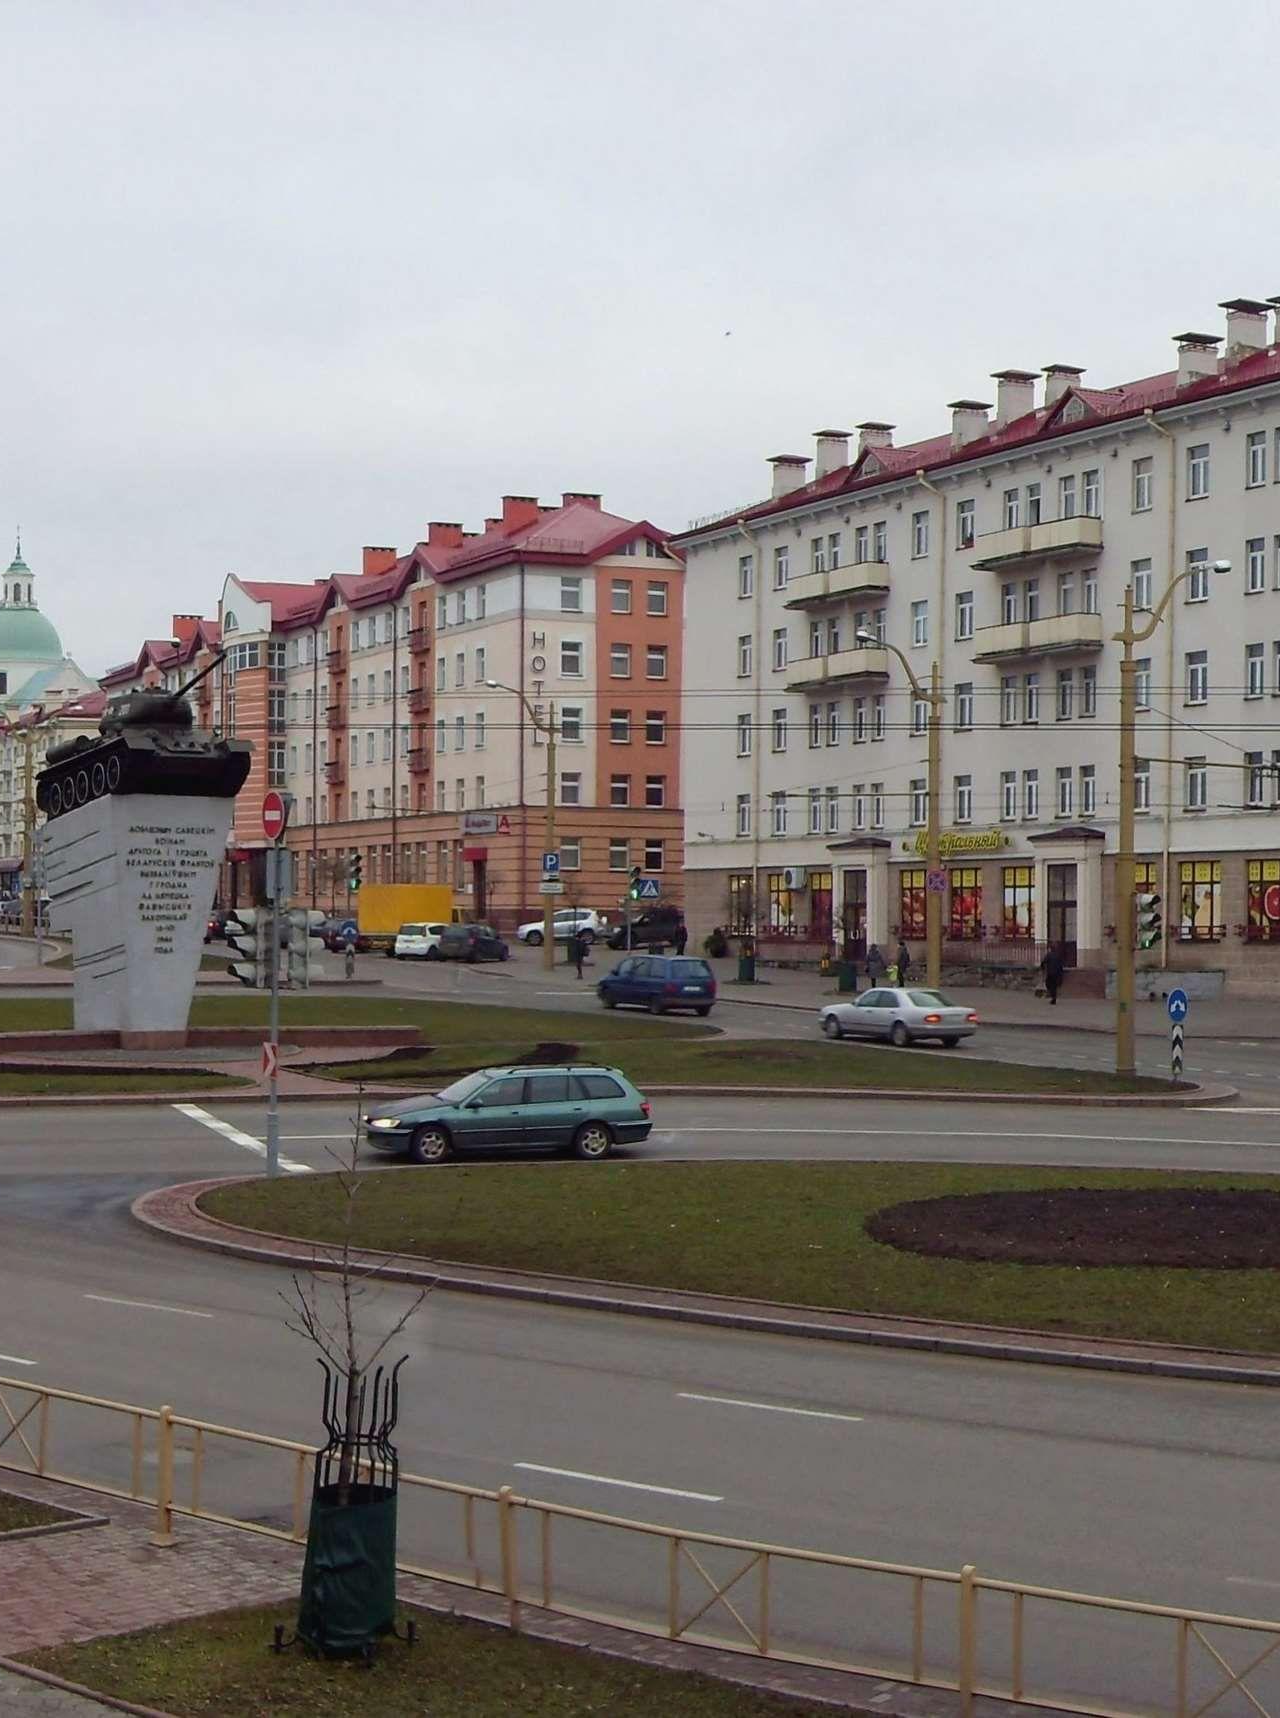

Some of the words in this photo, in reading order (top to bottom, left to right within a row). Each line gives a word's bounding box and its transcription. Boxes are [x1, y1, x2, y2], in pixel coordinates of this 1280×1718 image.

[532, 631, 546, 746] HOTEL
[915, 830, 1001, 855] Цтральный
[547, 855, 557, 870] P
